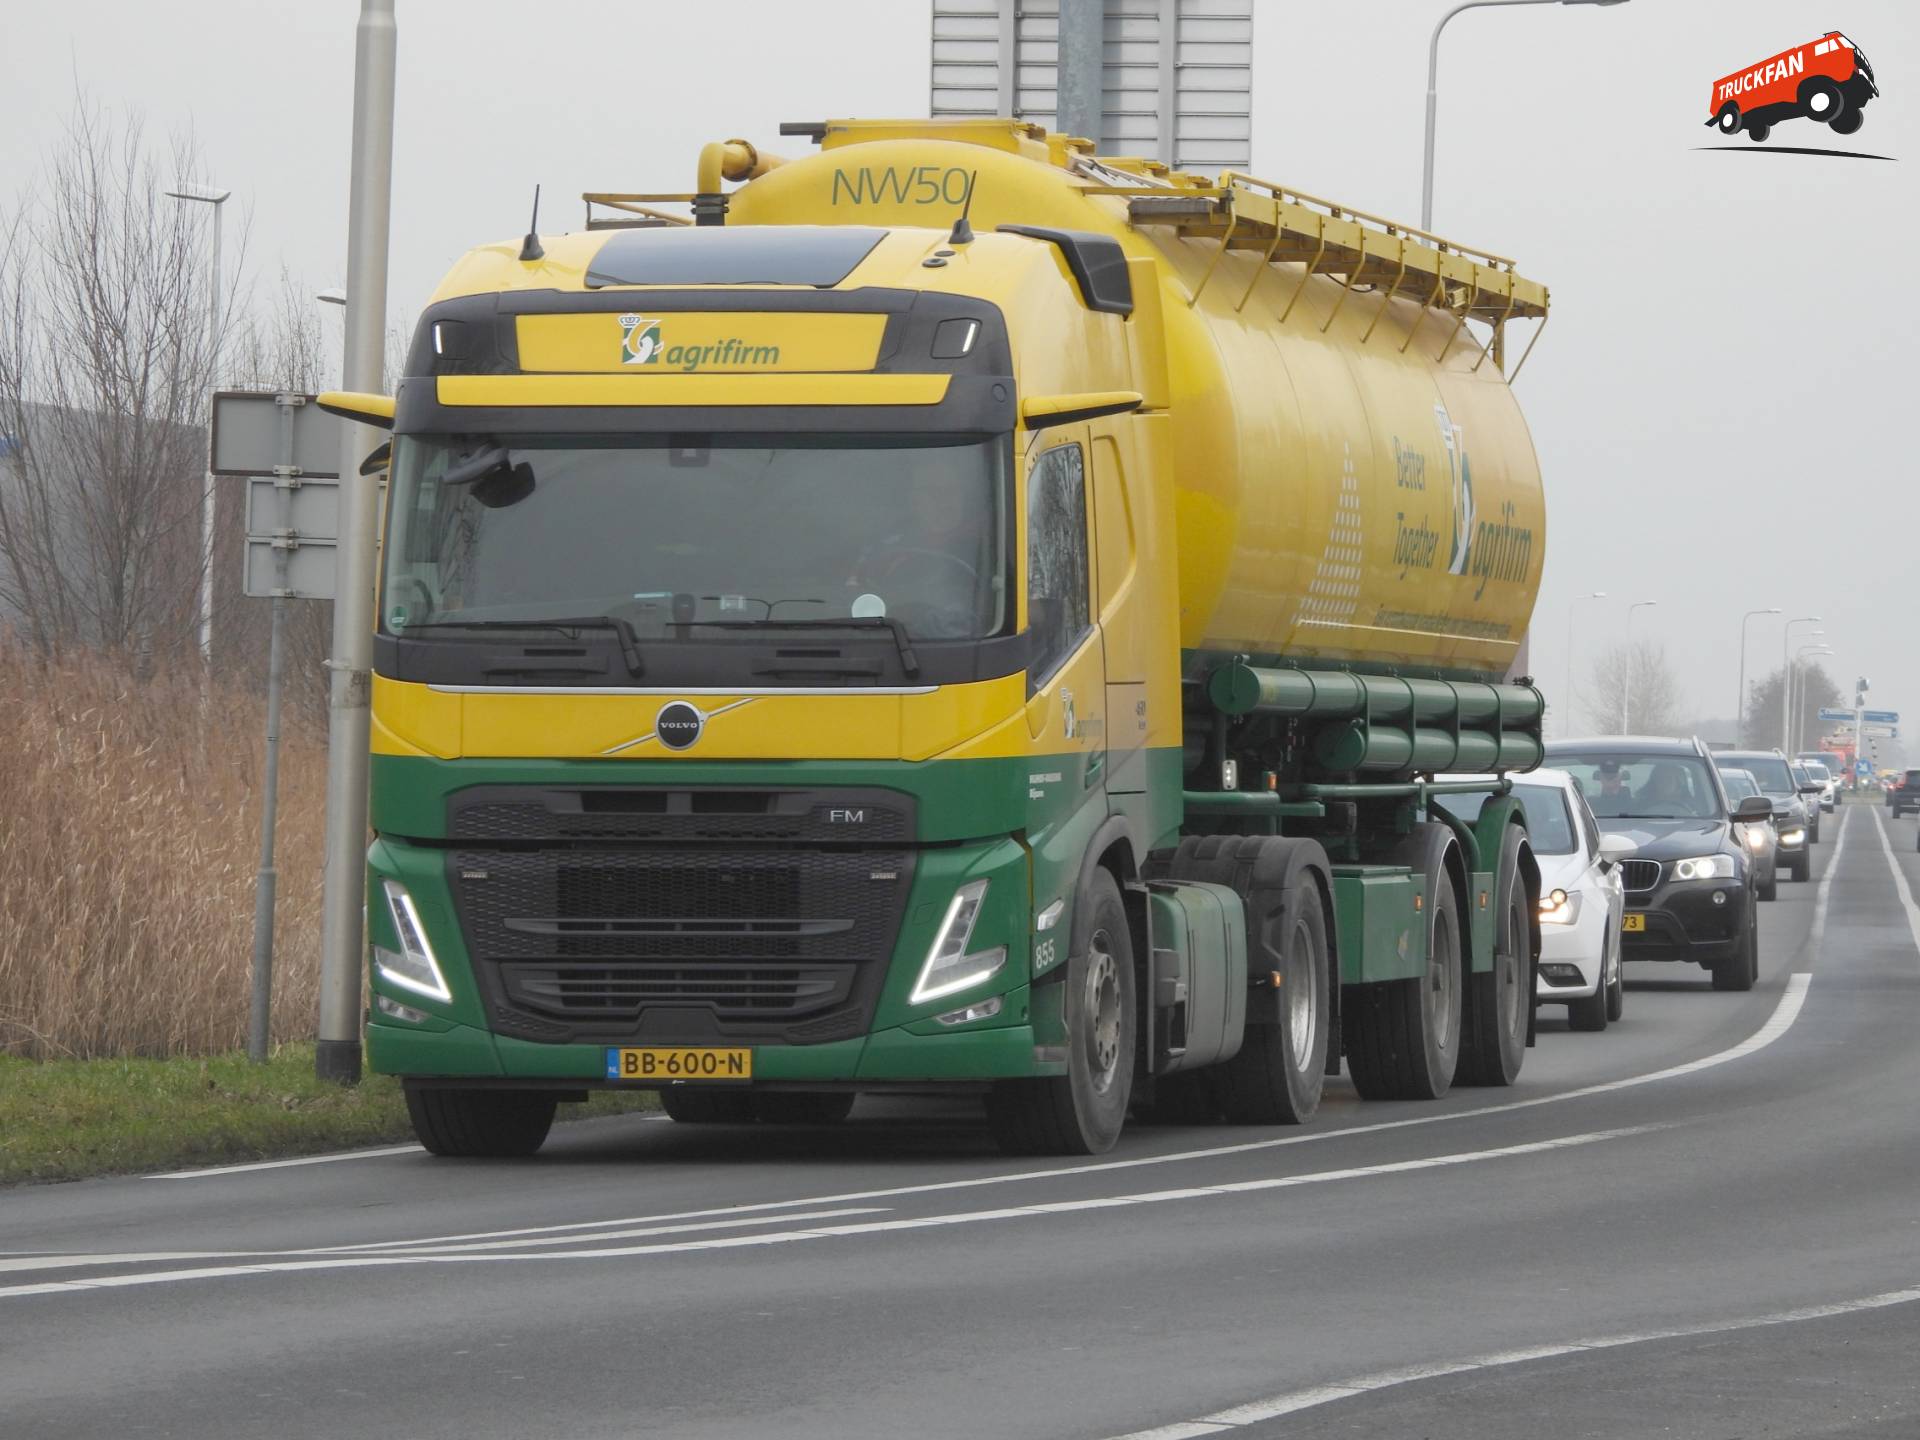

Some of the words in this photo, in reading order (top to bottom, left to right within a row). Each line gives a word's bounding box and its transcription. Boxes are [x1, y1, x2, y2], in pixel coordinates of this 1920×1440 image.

[832, 167, 970, 205] NW50
[666, 339, 780, 371] agrifirm
[1393, 435, 1426, 490] Better
[1393, 511, 1440, 580] Together
[1472, 499, 1531, 602] agrifirm
[830, 810, 864, 822] FM
[1035, 939, 1055, 969] 855
[625, 1053, 743, 1074] BB-600-N
